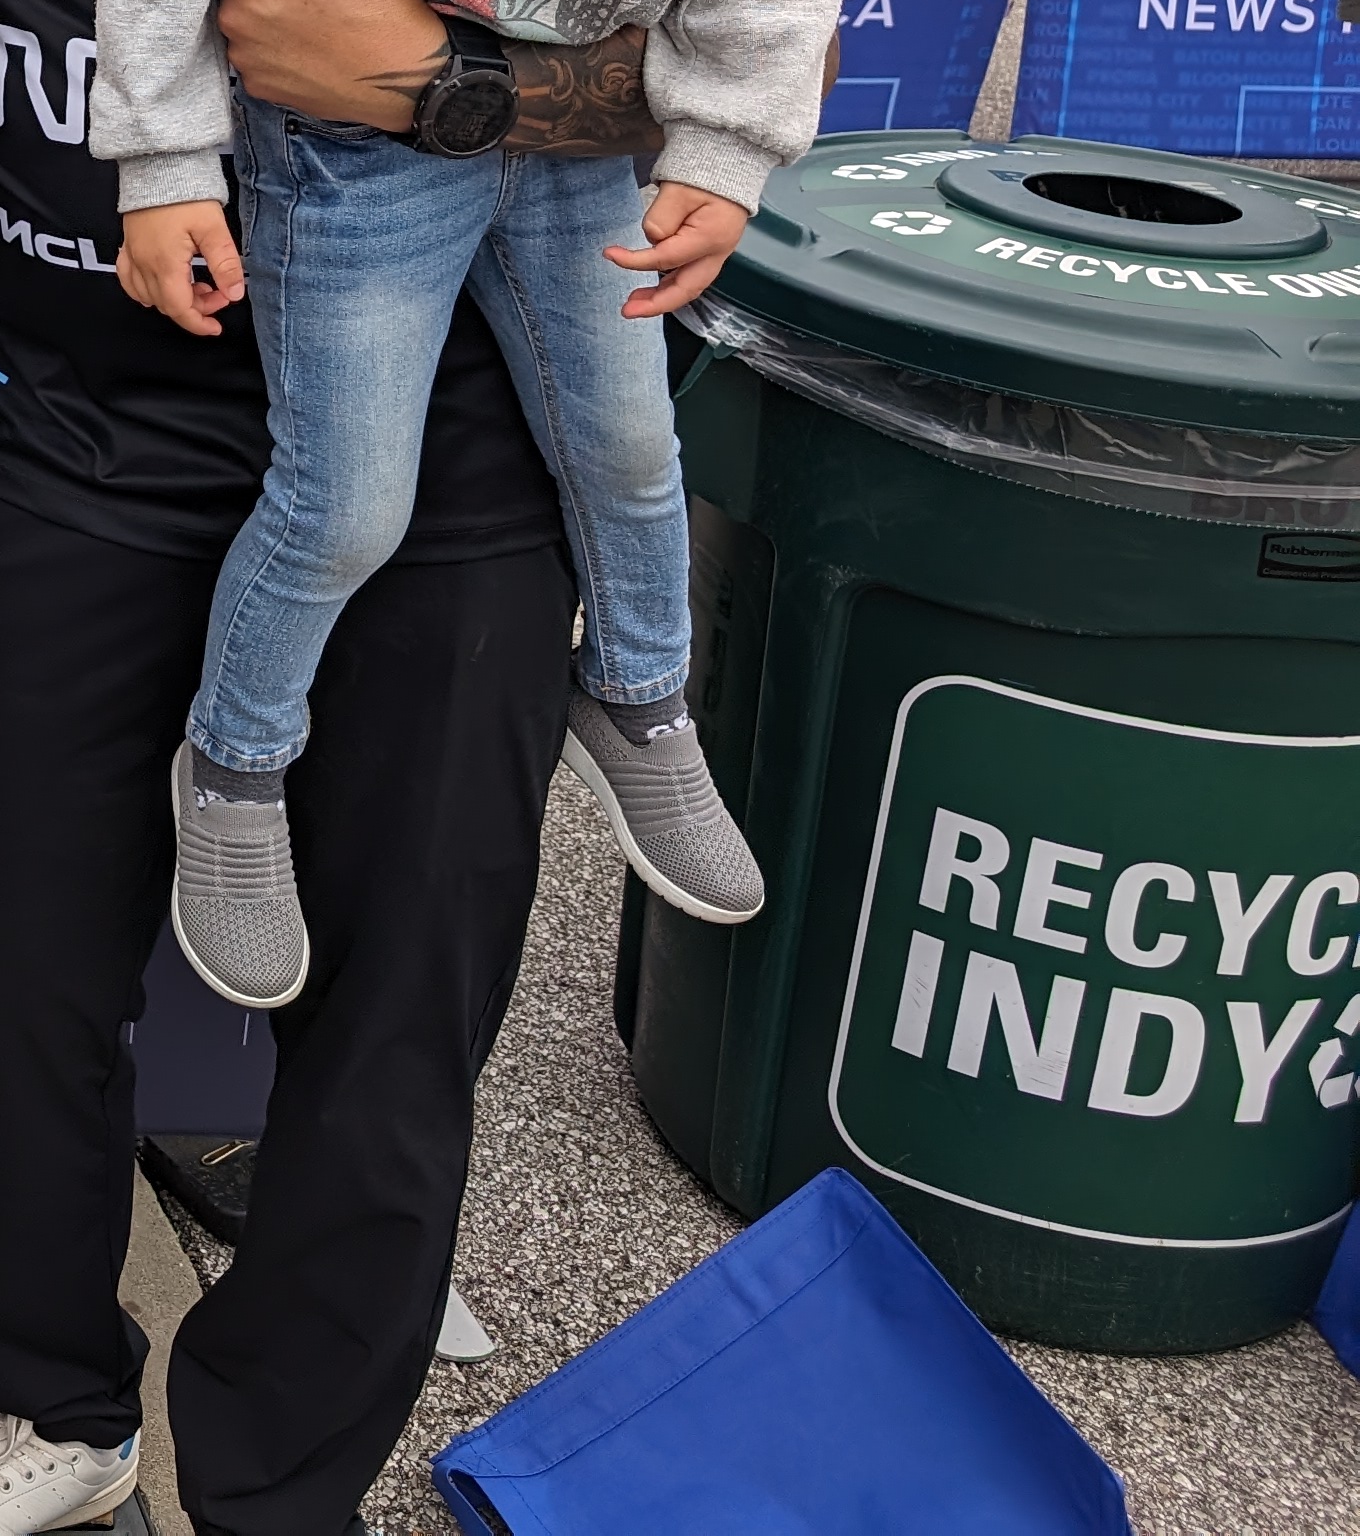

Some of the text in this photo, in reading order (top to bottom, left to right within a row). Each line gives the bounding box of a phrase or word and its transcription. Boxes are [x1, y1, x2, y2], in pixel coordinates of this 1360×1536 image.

[974, 237, 1269, 298] RECYCLE
[919, 806, 1360, 977] RECYC
[890, 929, 1322, 1124] INDY
